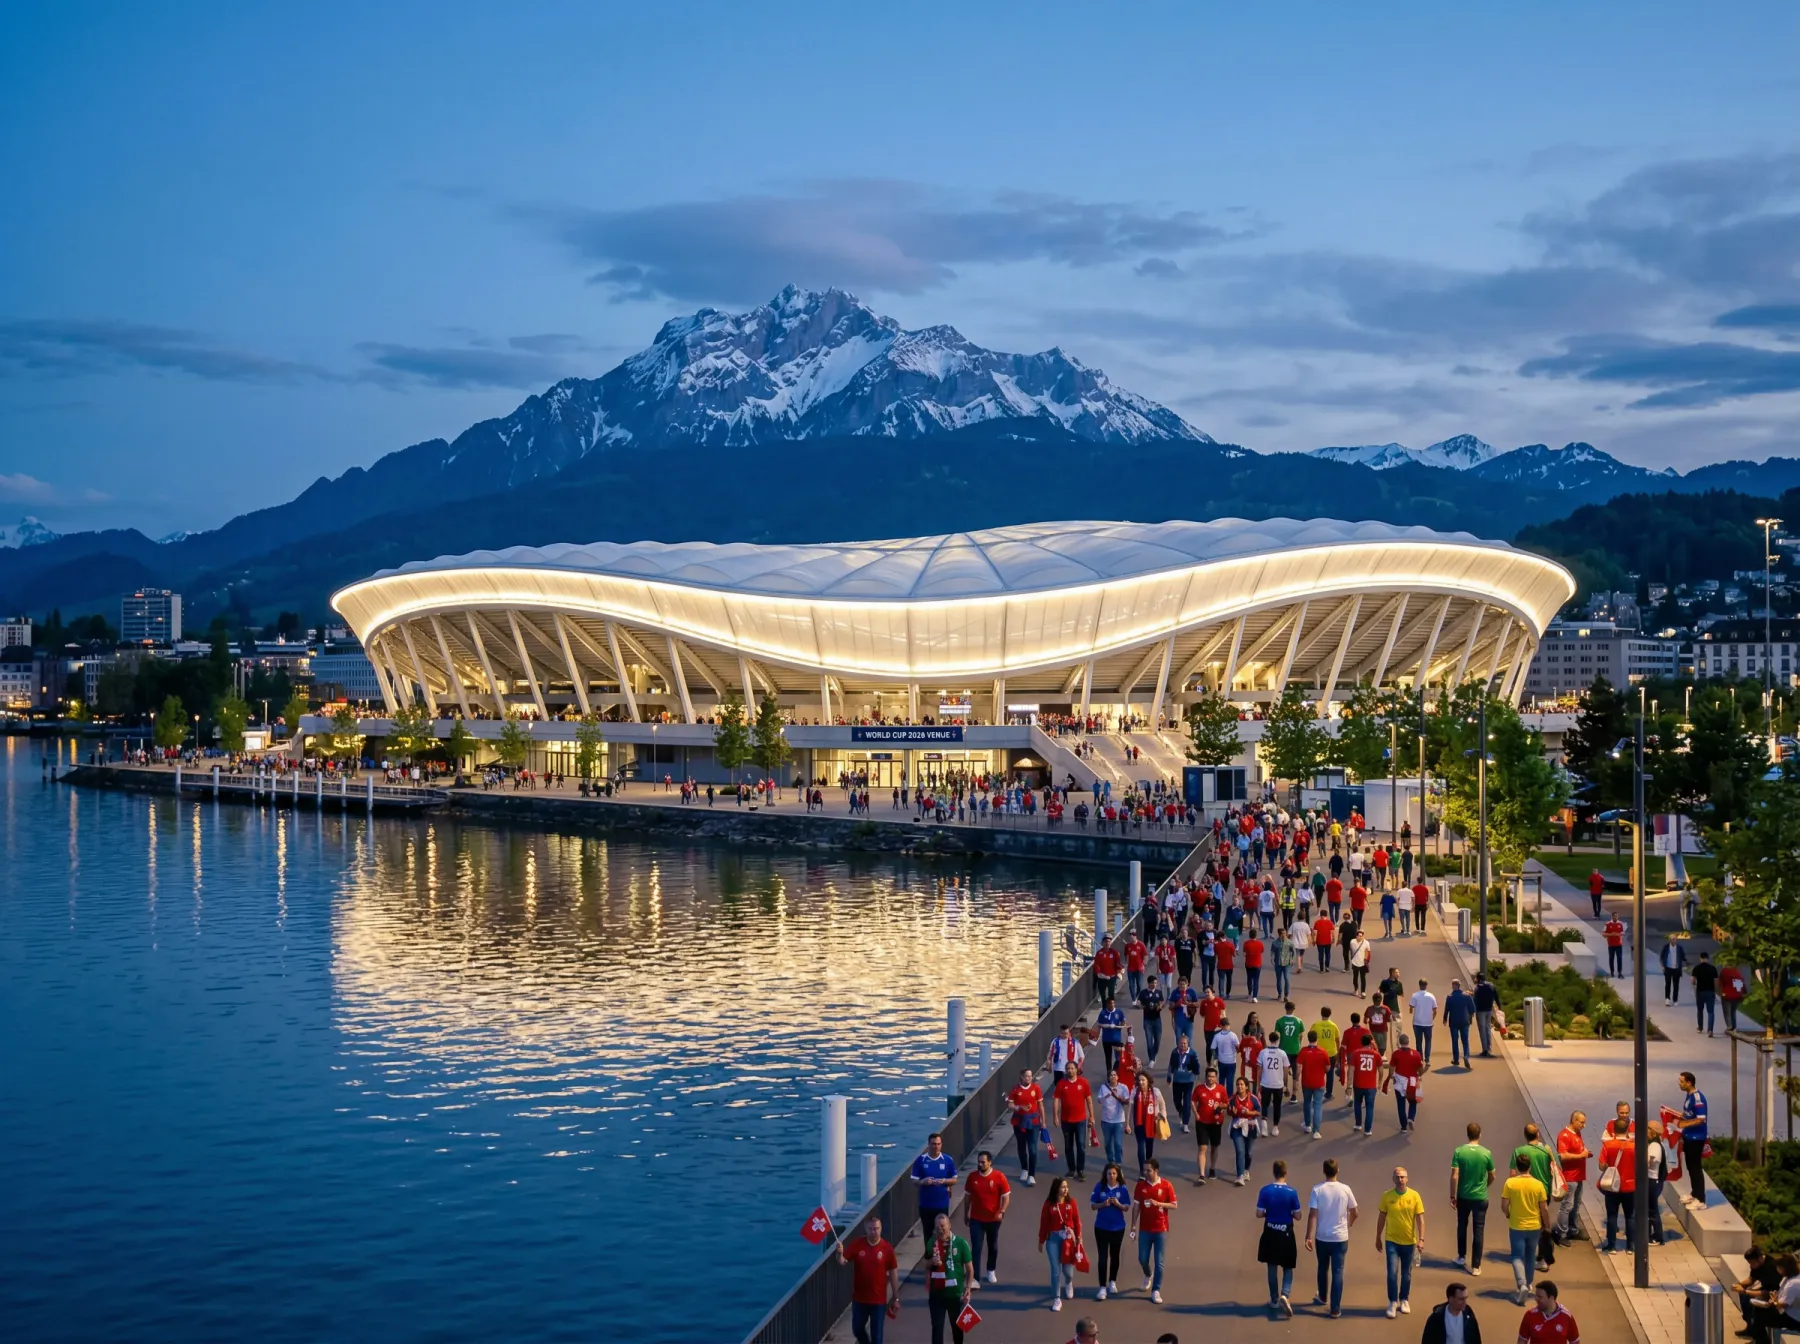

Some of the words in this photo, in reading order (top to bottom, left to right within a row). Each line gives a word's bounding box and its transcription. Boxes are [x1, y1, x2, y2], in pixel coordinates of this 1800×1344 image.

[865, 731, 891, 739] WORLD
[892, 731, 907, 739] CUP
[926, 731, 951, 739] VENUE
